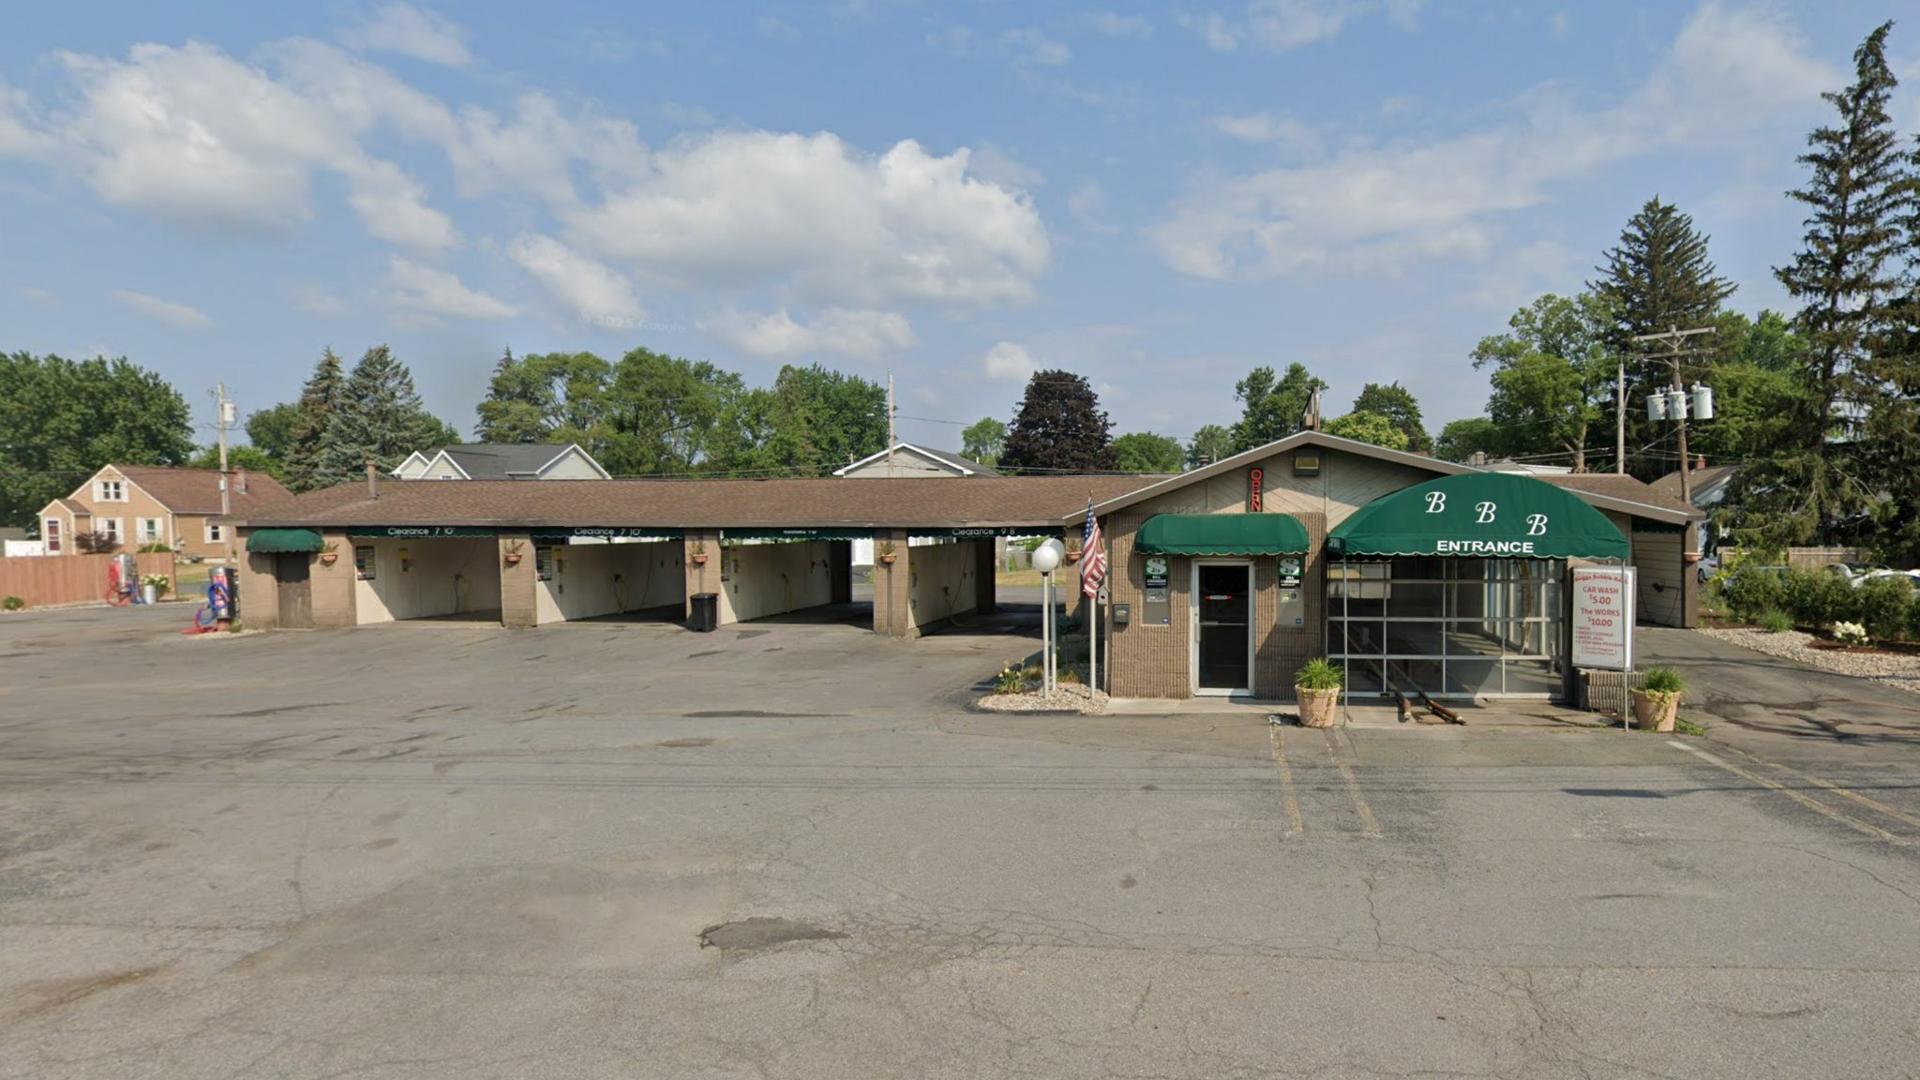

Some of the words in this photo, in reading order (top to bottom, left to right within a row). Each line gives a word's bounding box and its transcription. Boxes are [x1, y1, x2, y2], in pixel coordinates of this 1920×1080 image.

[1250, 468, 1262, 512] OPEN
[1425, 491, 1446, 513] B
[1475, 501, 1497, 523] B
[1526, 513, 1548, 536] B
[387, 527, 430, 536] Clearance
[574, 528, 615, 536] Clearance
[952, 528, 995, 536] Clearance
[1436, 540, 1535, 554] ENTRANCE
[1580, 607, 1593, 615] The
[1594, 608, 1621, 617] WORKS
